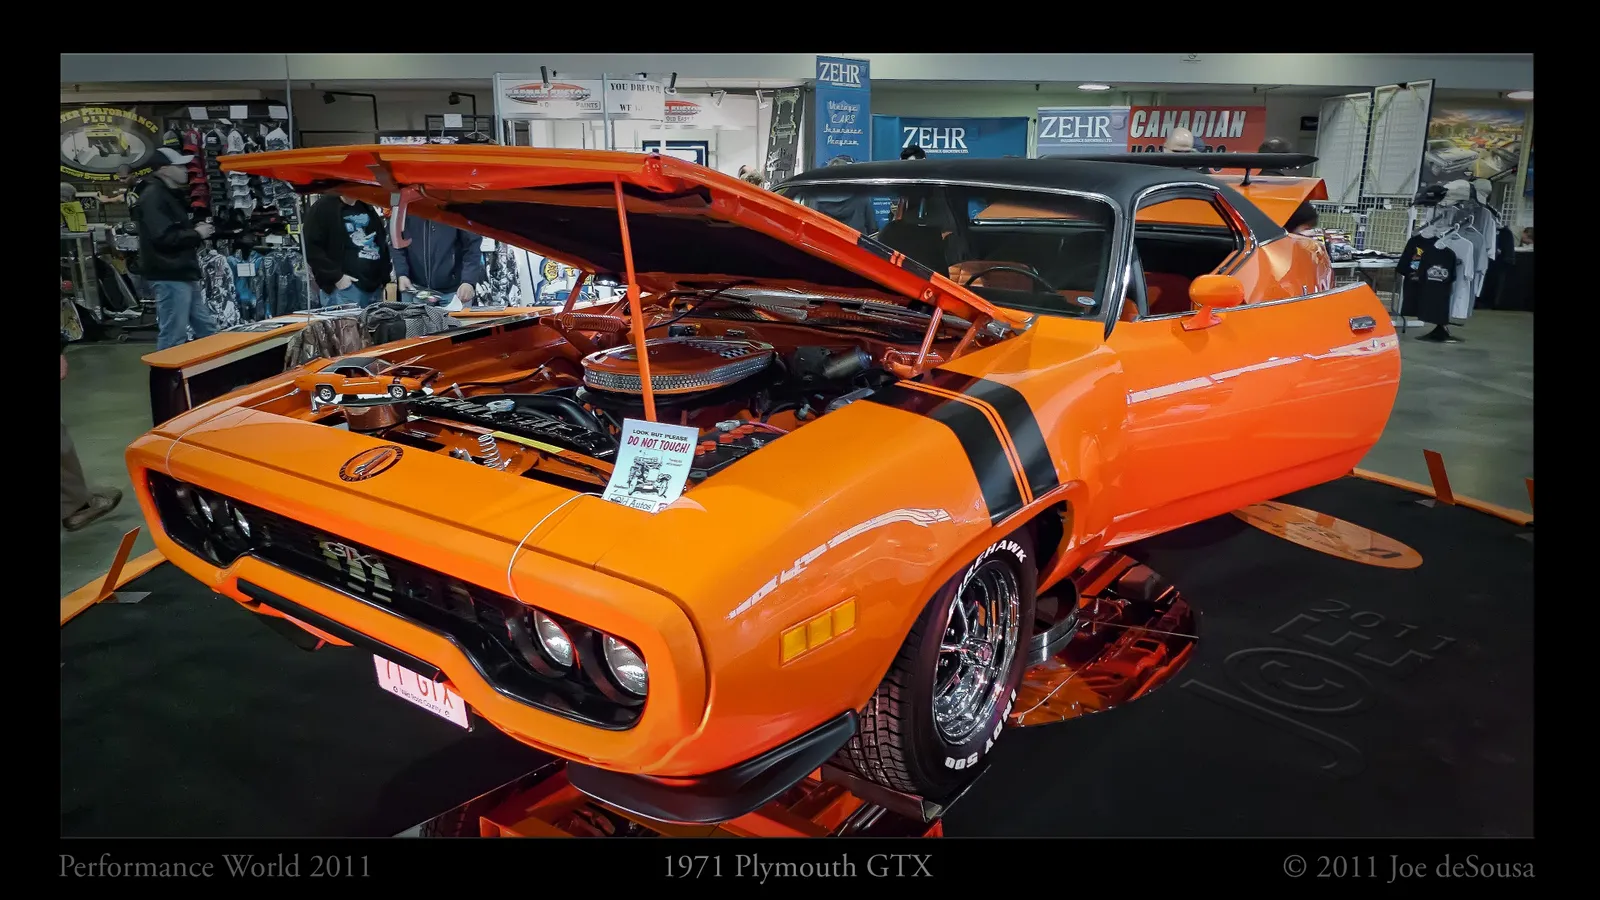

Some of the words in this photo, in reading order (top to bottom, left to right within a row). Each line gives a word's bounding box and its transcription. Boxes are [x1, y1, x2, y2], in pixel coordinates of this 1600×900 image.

[818, 61, 861, 85] ZEHR
[610, 82, 628, 91] YOU
[80, 107, 159, 134] PERFORMANCE
[82, 115, 113, 124] PLUS
[831, 113, 856, 124] CARS
[1039, 116, 1112, 139] ZEHR
[1130, 110, 1247, 139] CANADIAN
[902, 127, 968, 149] ZEHR
[627, 435, 640, 446] DO
[640, 437, 659, 449] NOT
[659, 439, 691, 454] TOUCH!
[664, 434, 688, 442] PLEASE
[944, 750, 979, 771] 500
